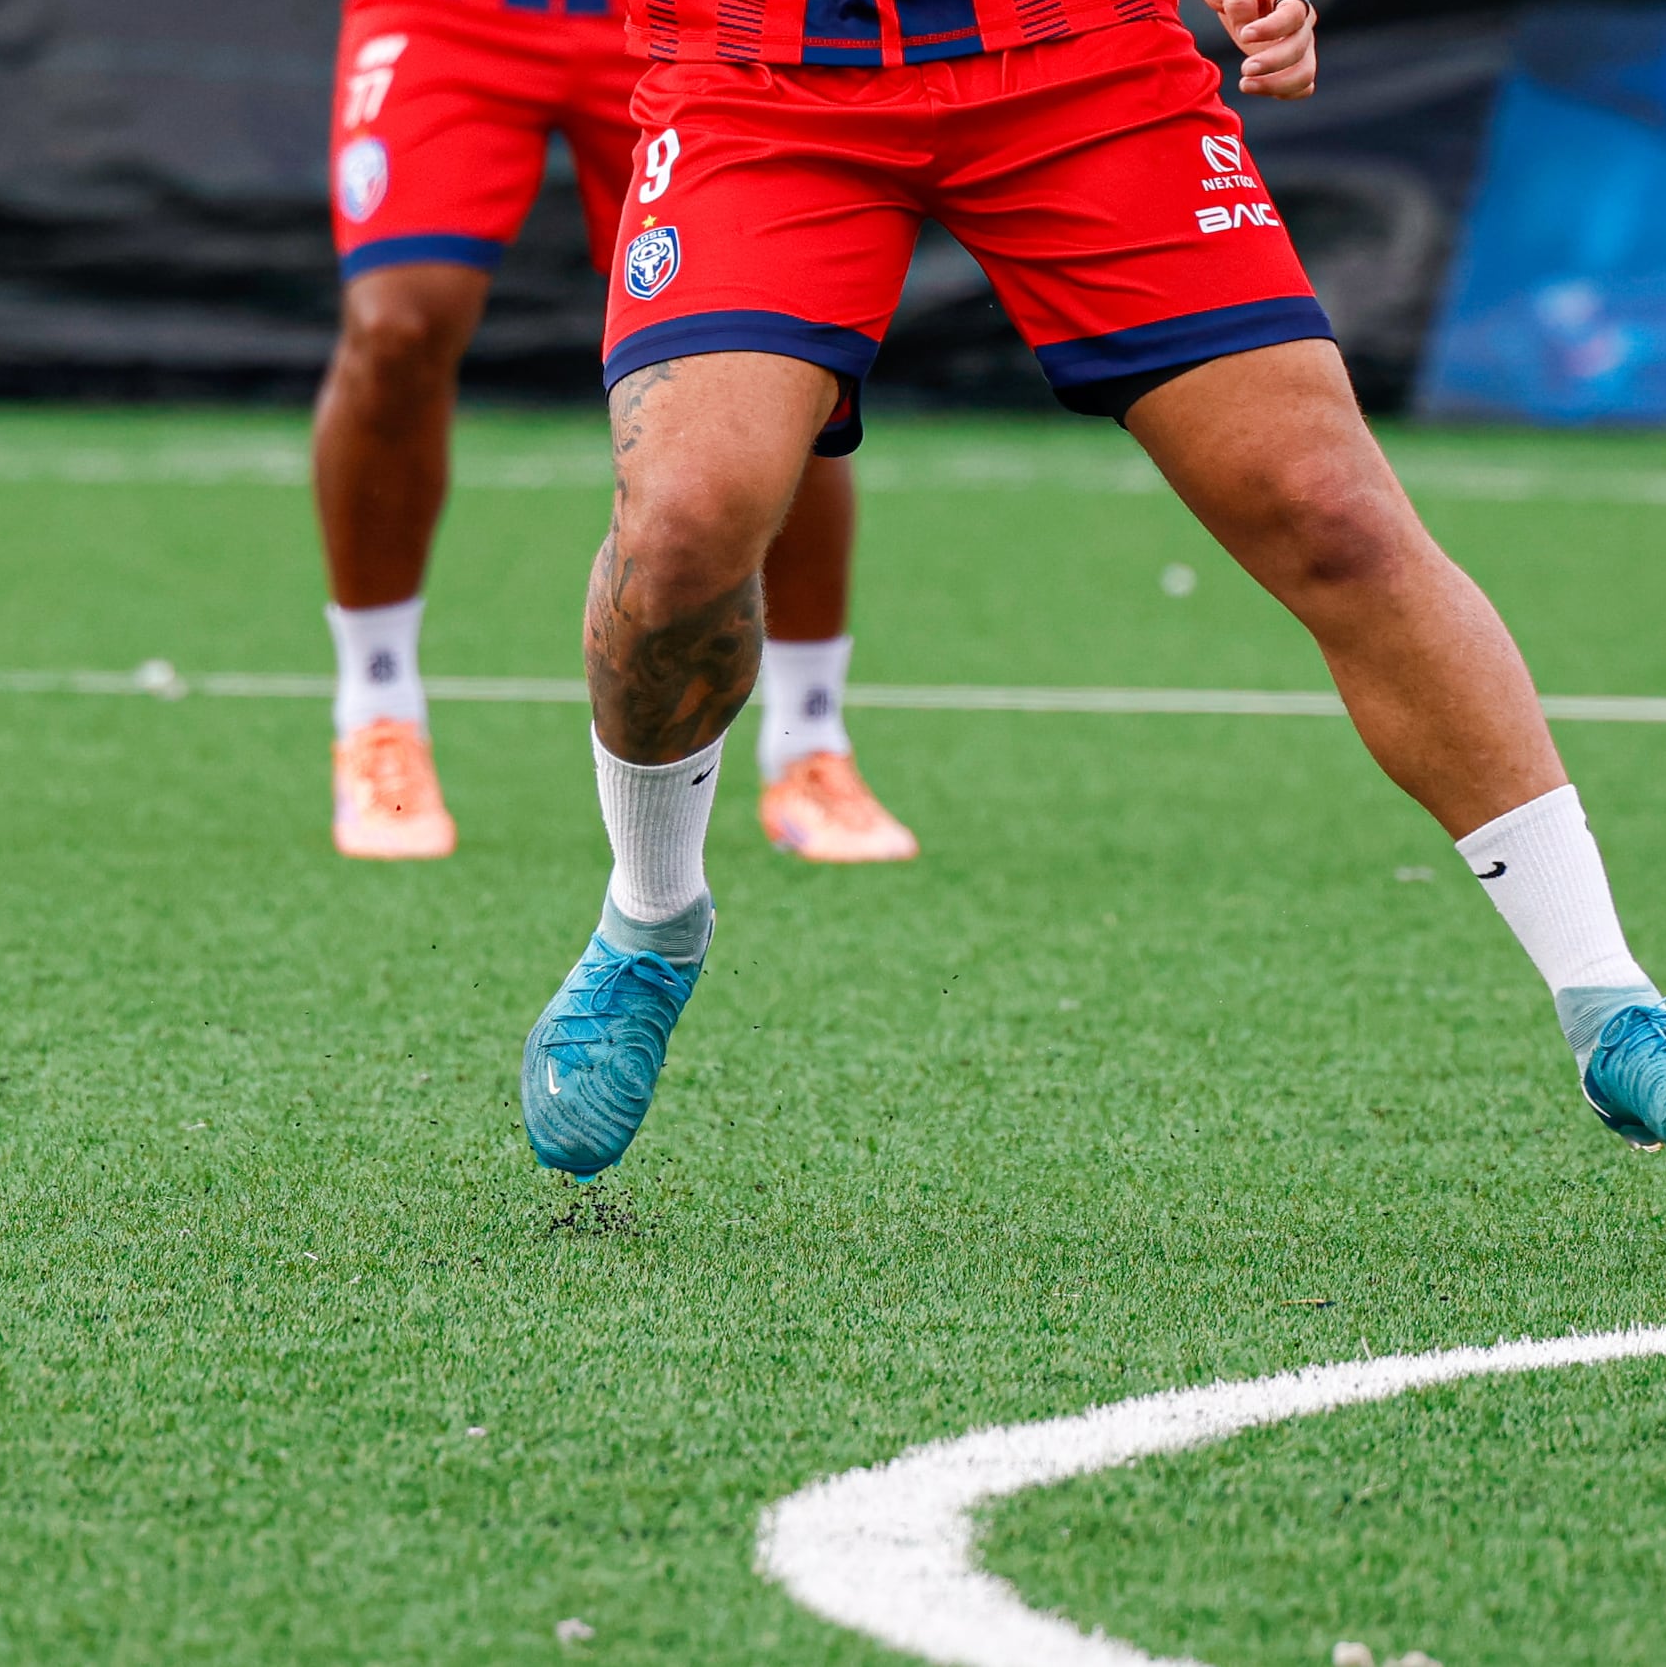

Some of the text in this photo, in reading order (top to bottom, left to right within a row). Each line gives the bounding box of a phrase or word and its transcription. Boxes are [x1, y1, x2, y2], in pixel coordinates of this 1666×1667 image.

[639, 128, 680, 204] 9
[1195, 203, 1280, 234] BAIC
[633, 229, 668, 248] ADSC
